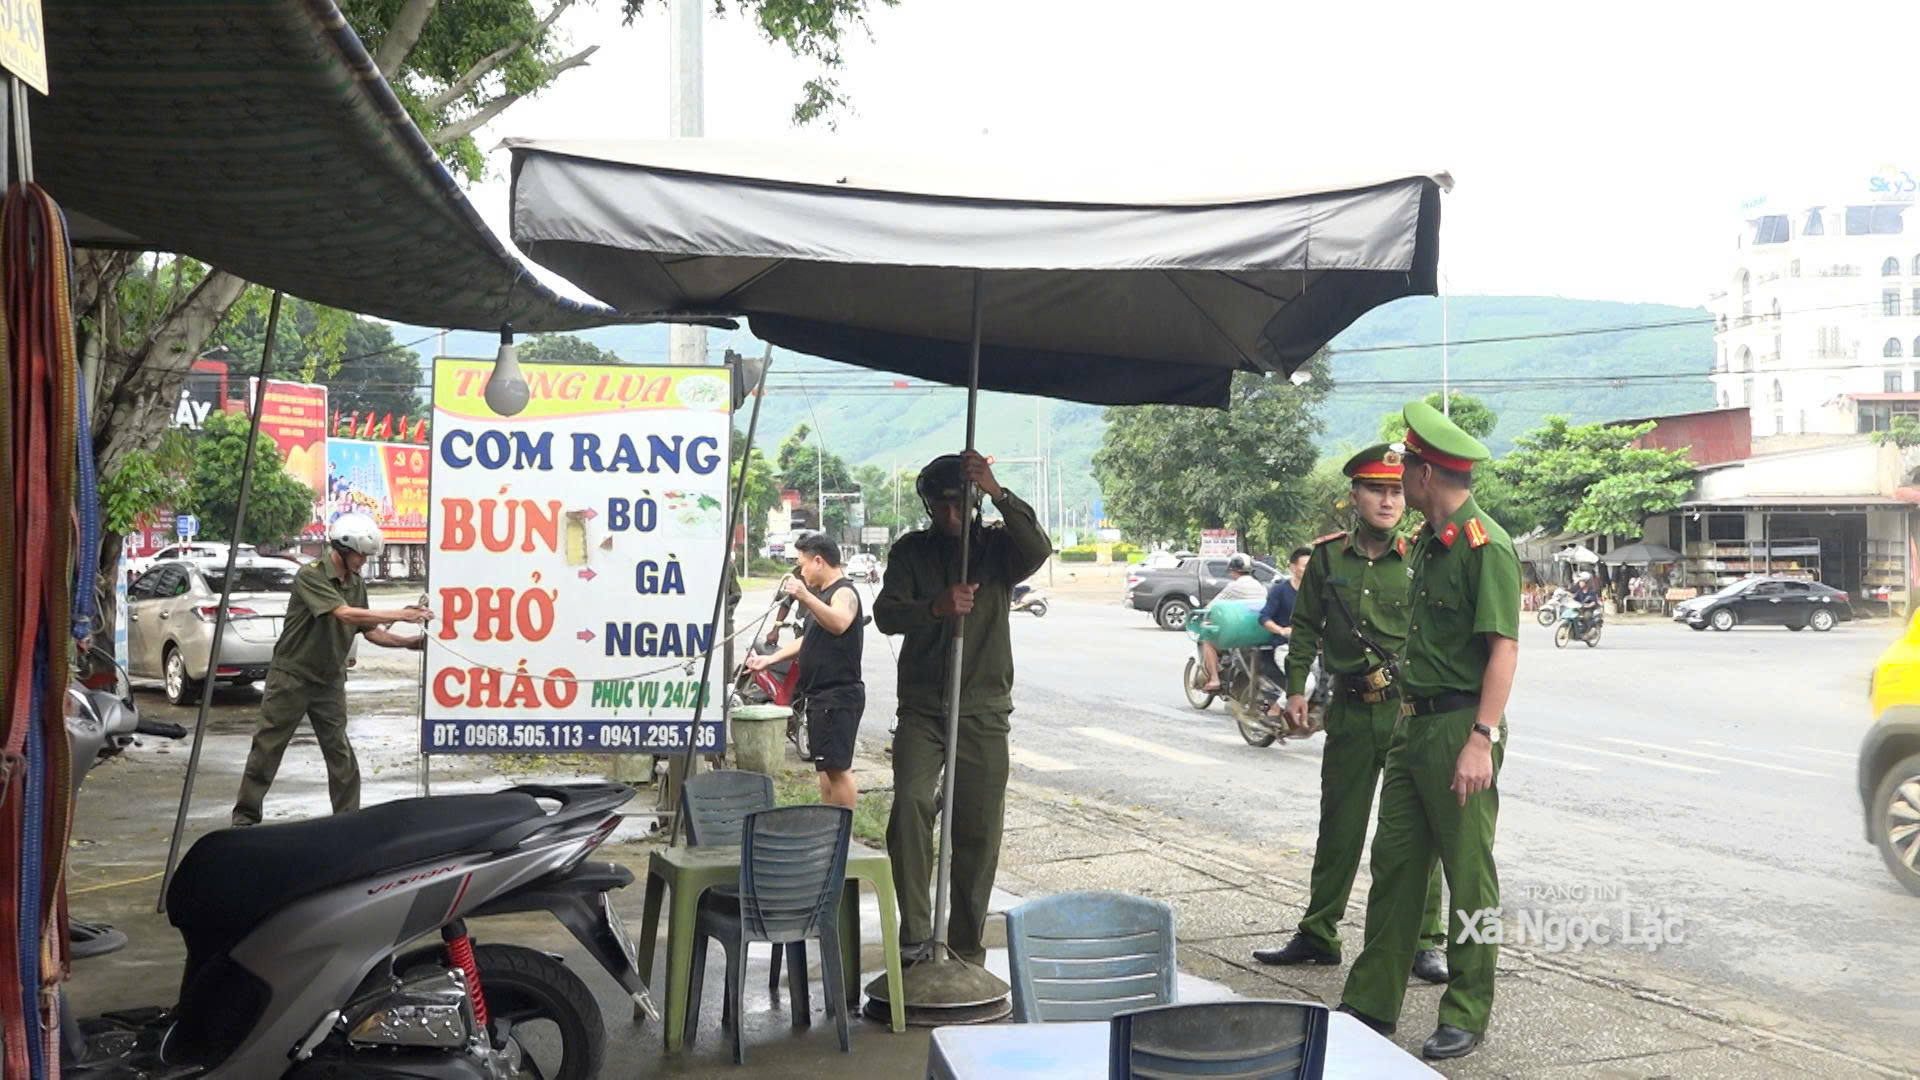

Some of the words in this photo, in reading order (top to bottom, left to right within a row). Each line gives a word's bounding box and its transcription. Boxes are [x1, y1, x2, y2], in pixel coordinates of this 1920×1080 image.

[440, 429, 554, 470] CƠM
[570, 432, 721, 475] RANG
[440, 484, 562, 552] BÚN
[608, 489, 657, 532] BÒ
[635, 553, 686, 594] GÀ
[439, 571, 559, 642] PHỞ
[605, 621, 714, 658] NGAN
[432, 658, 578, 709] CHÁO
[591, 681, 635, 716] PHỤC
[638, 681, 660, 716] VỤ
[433, 725, 460, 746] ĐT:
[465, 724, 583, 747] 0968.505.113
[600, 724, 716, 747] 0941.295.136
[367, 864, 459, 895] VISION
